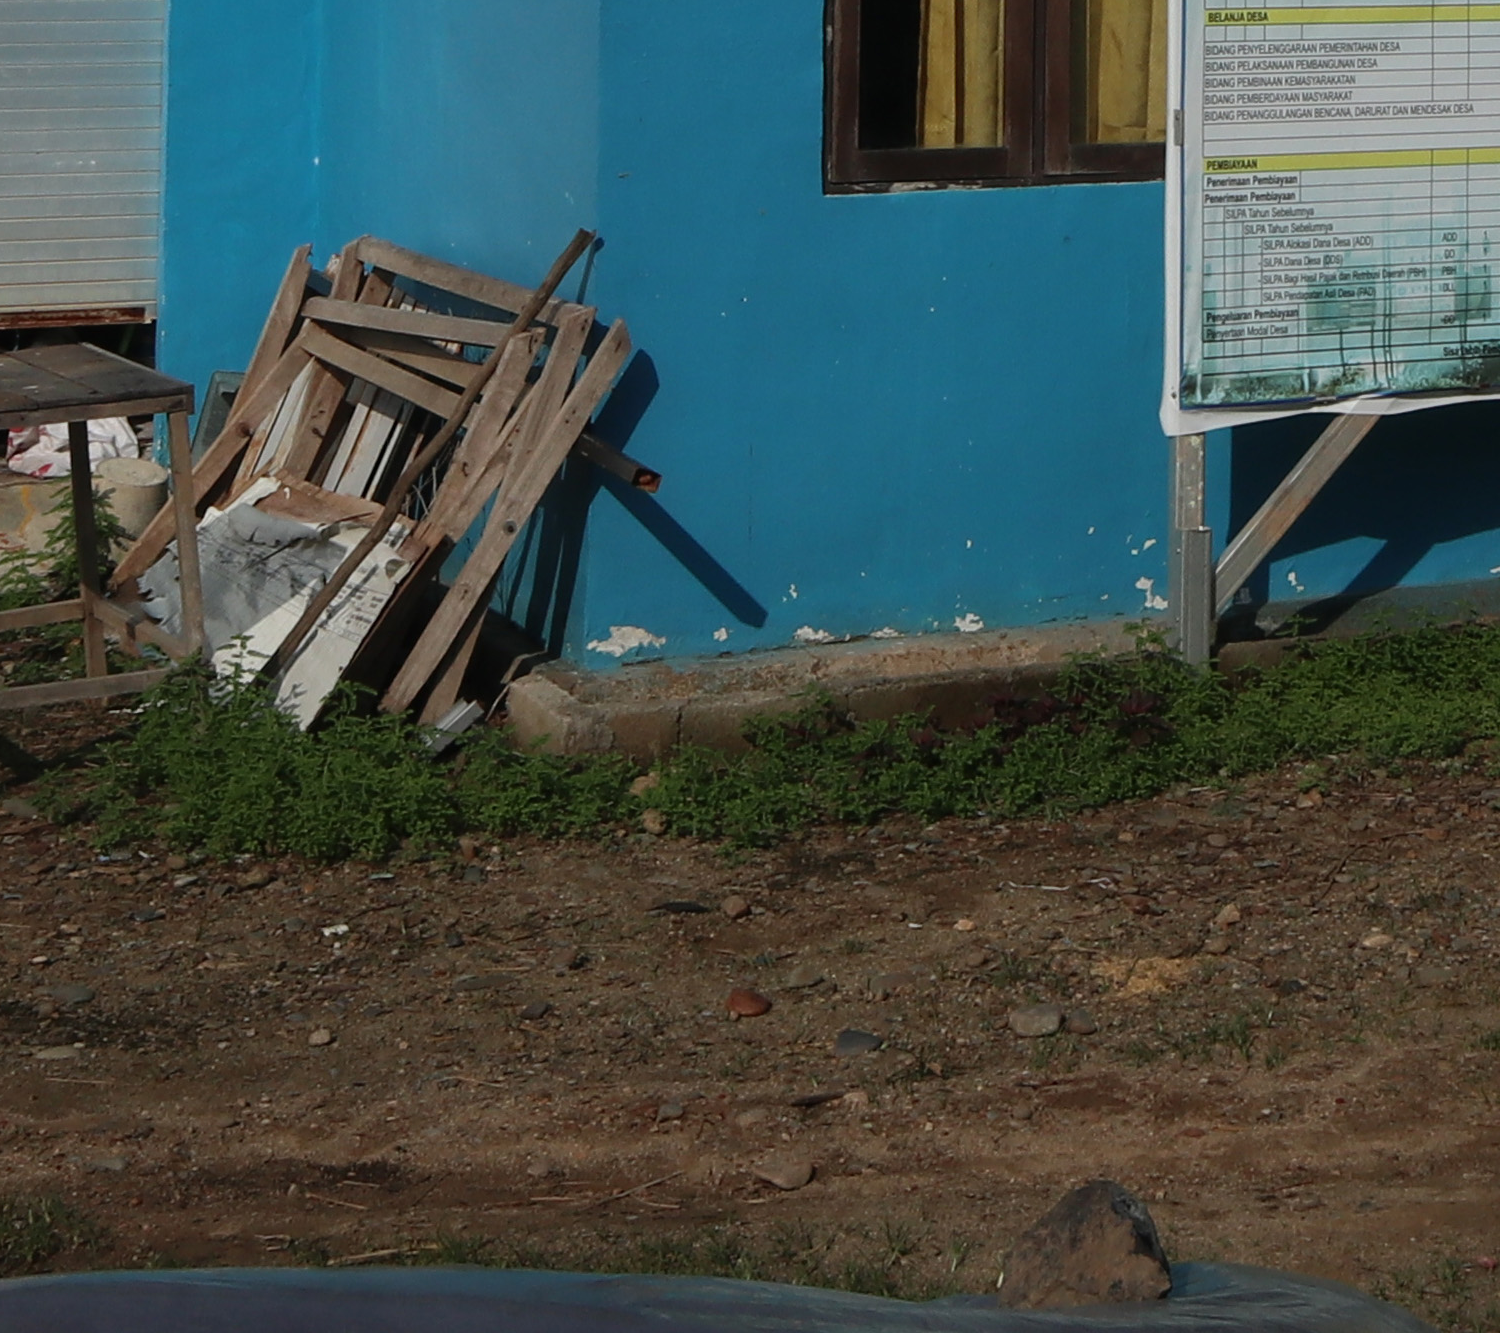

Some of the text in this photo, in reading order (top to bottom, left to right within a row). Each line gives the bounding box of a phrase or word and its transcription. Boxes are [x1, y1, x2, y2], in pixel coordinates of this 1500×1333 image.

[1208, 11, 1268, 22] BELANJA DESA
[1205, 41, 1400, 55] BIDANG PENYELENGGARAAN PEMERINTAHAN DESA
[1207, 159, 1258, 170] PEMBIAYAAN
